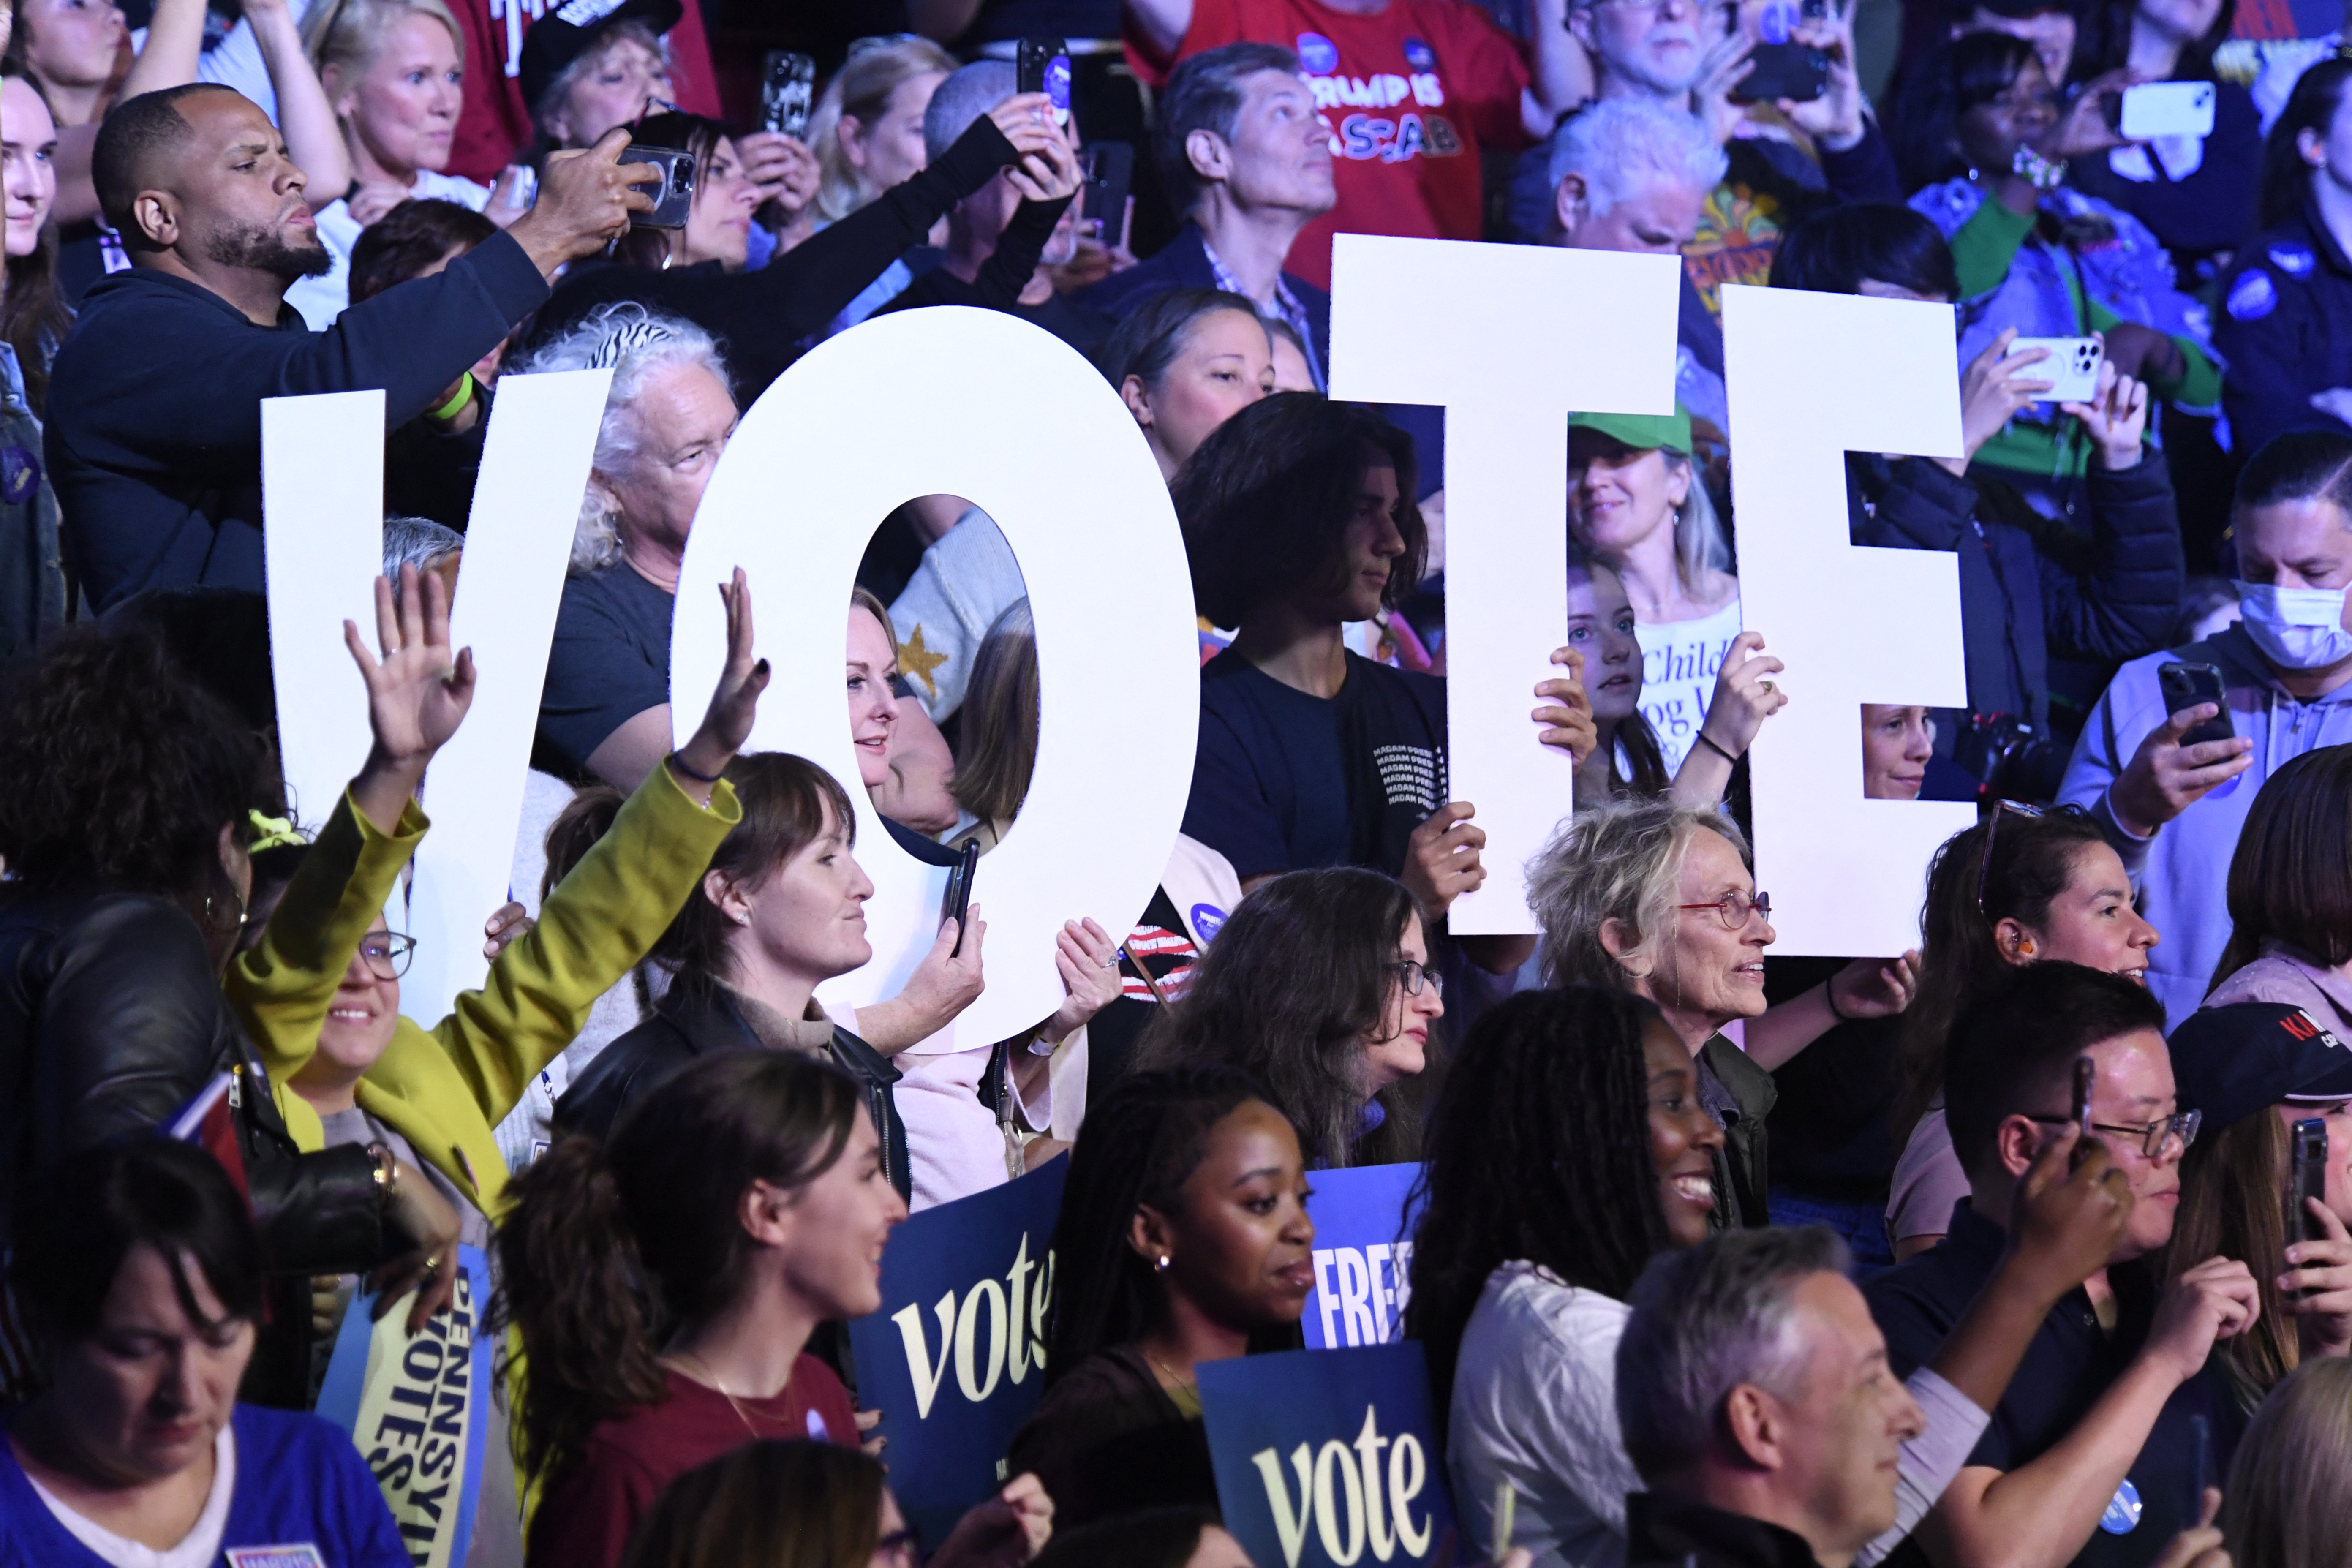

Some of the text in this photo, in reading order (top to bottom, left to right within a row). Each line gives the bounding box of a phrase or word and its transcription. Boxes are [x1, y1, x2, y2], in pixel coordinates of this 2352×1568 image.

[1409, 72, 1445, 107] IS
[261, 233, 1978, 1055] VOTE
[1642, 699, 1689, 736] og
[1373, 745, 1407, 757] MADAM
[1376, 754, 1410, 766] MADAM
[1380, 764, 1412, 776] MADAM
[1383, 774, 1414, 786] MADAM
[1386, 784, 1415, 795] MADAM
[1388, 794, 1416, 806] MADAM
[890, 1231, 1055, 1420] vote
[1251, 1403, 1433, 1568] vote
